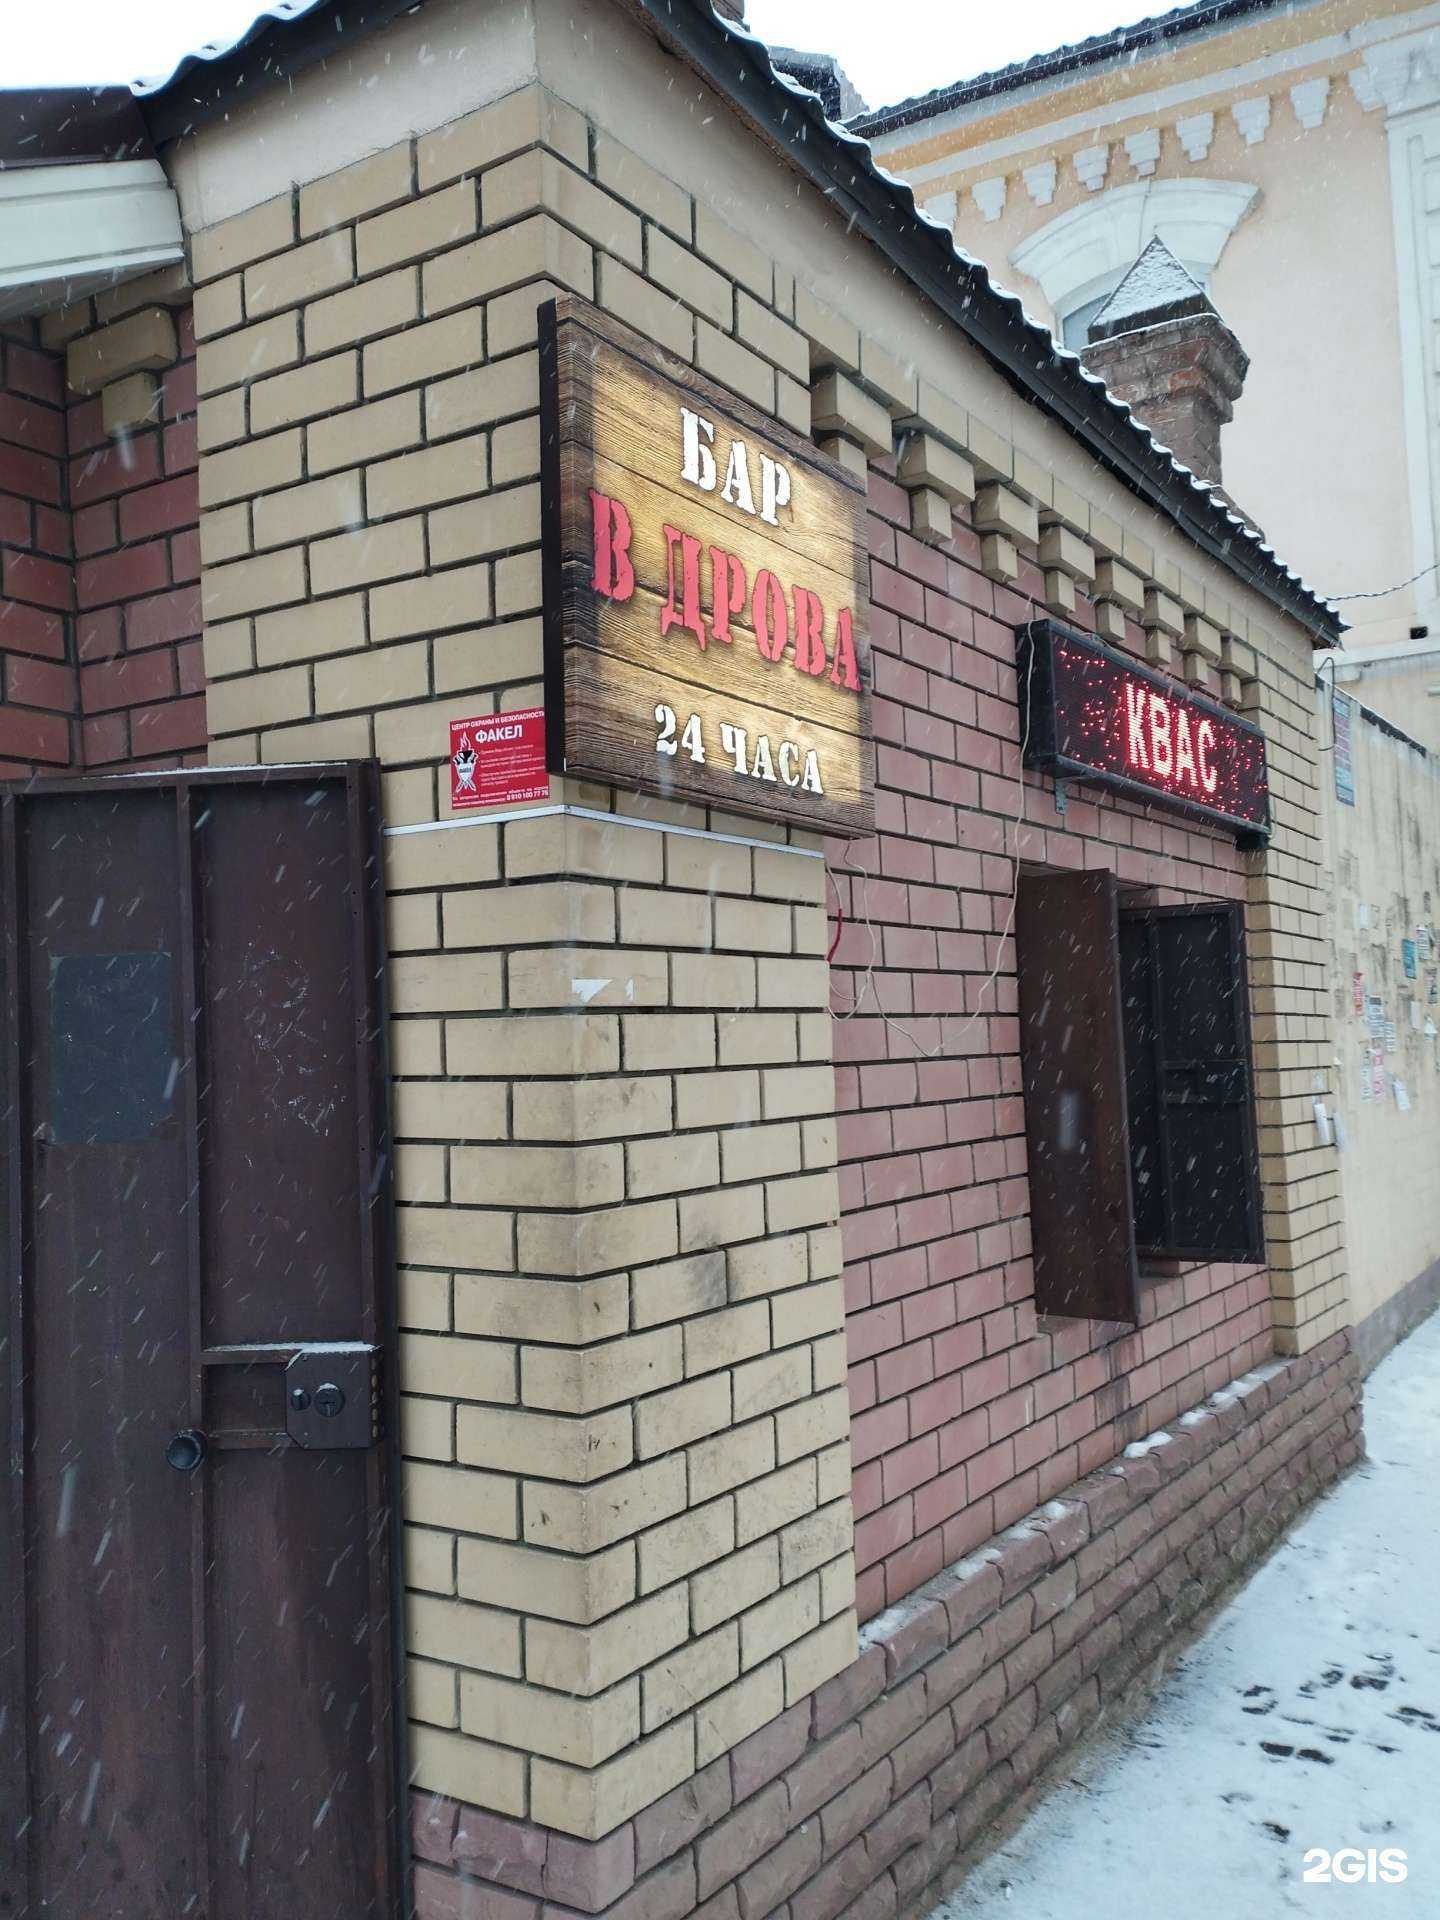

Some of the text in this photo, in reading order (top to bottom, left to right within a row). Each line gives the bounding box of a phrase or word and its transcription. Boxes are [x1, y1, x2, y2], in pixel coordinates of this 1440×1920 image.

[681, 407, 792, 526] БАР
[588, 487, 863, 692] В ДРОВА
[451, 722, 470, 731] ЦЕНТР
[475, 724, 523, 744] ФАКЕЛ
[654, 703, 825, 795] 24 ЧАСА
[1125, 682, 1218, 793] КВАС
